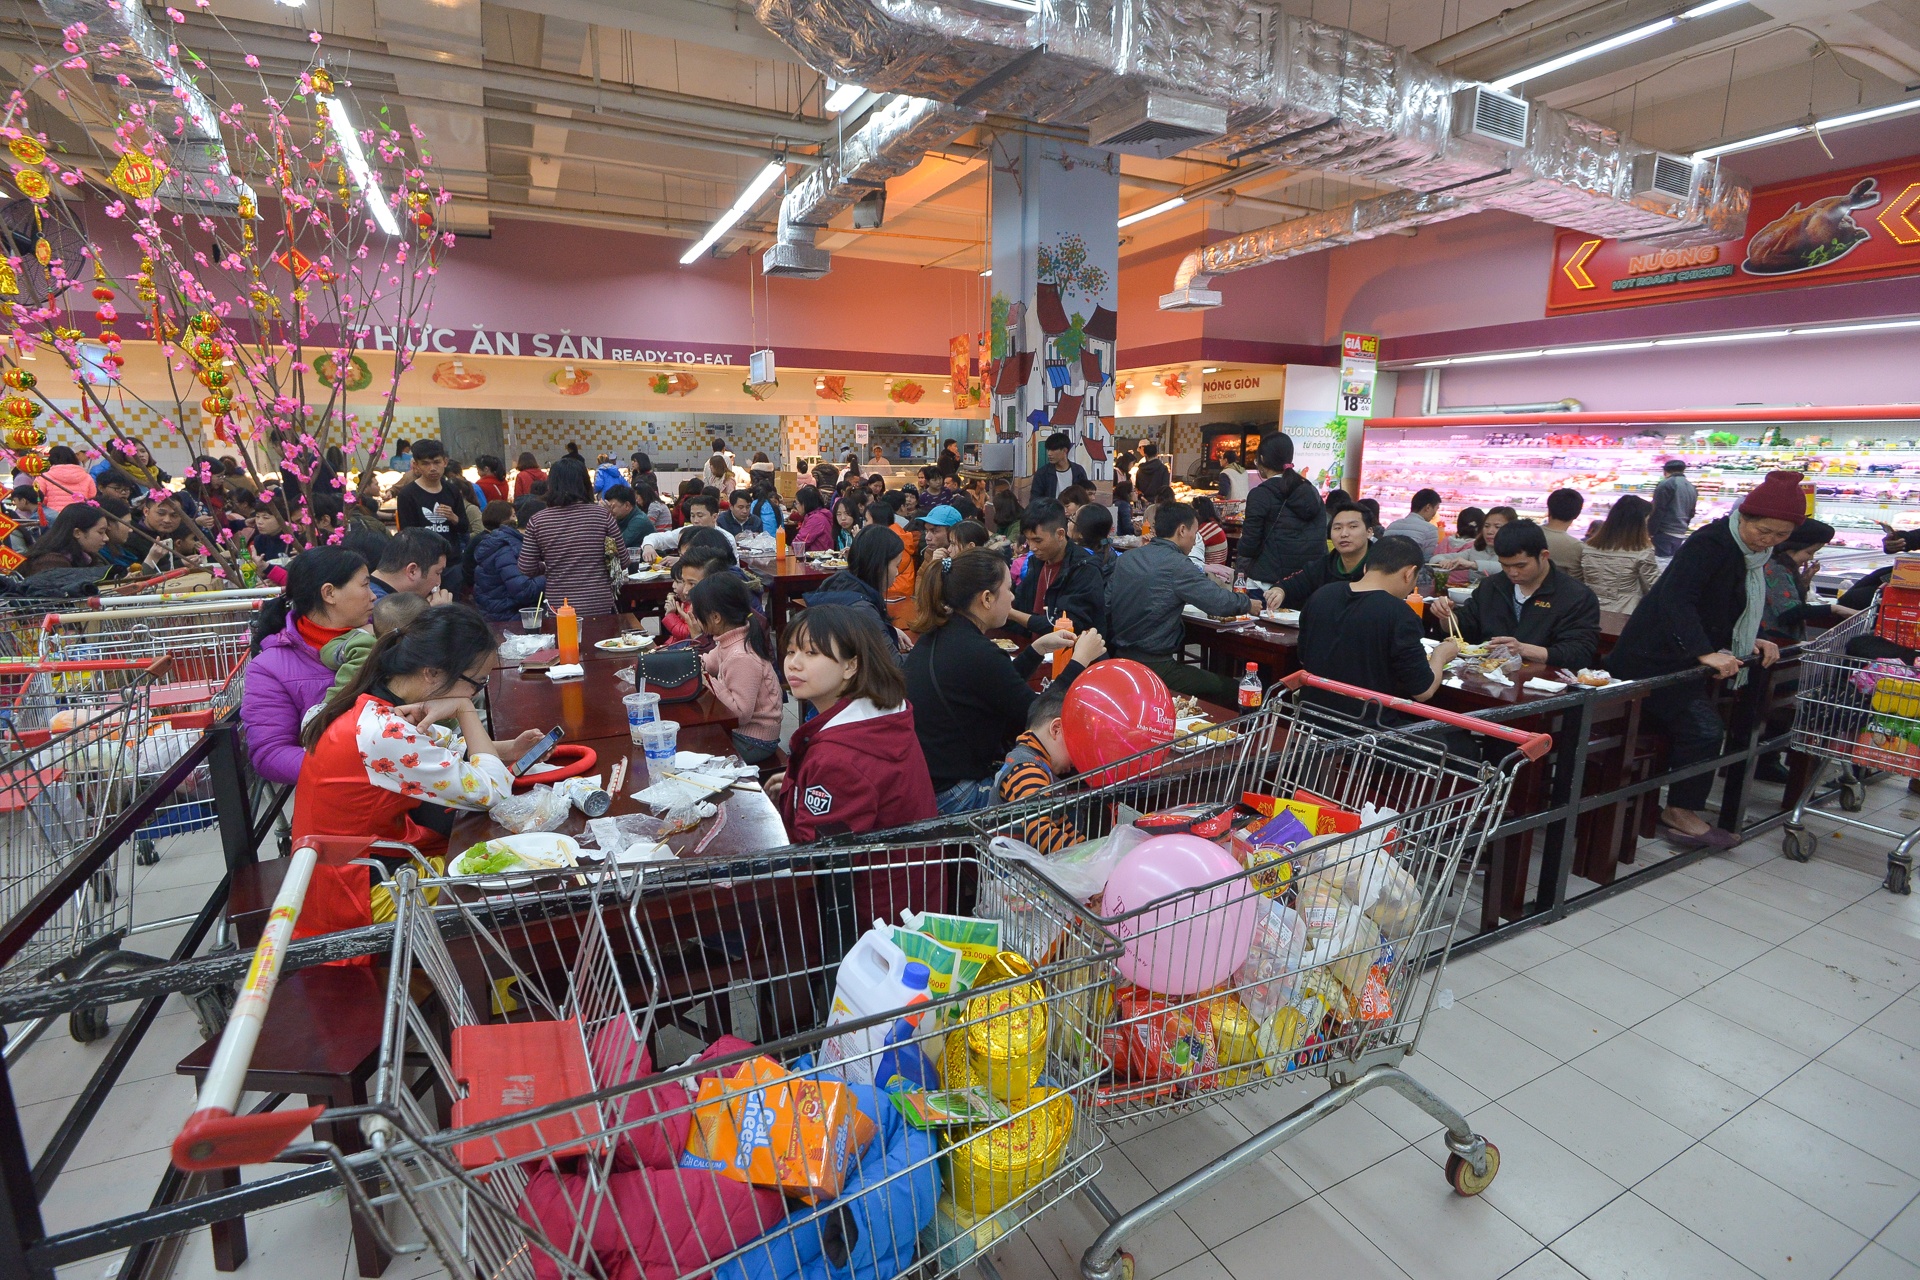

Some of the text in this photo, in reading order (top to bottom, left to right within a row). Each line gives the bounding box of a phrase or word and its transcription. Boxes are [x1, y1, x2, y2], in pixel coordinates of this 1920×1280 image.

[1612, 265, 1733, 291] HOT ROAST CHICKEN
[469, 322, 520, 357] ĂN
[1344, 336, 1361, 350] GIÁ
[611, 348, 733, 366] READY-TO-EAT
[1203, 375, 1260, 392] NÓNG GIÒN
[1343, 395, 1358, 412] 18
[1307, 427, 1332, 438] NGON
[1312, 441, 1330, 451] nông
[1534, 599, 1551, 608] FILA
[807, 794, 828, 809] 007
[736, 1088, 765, 1168] Cheese
[754, 1108, 775, 1146] Cal
